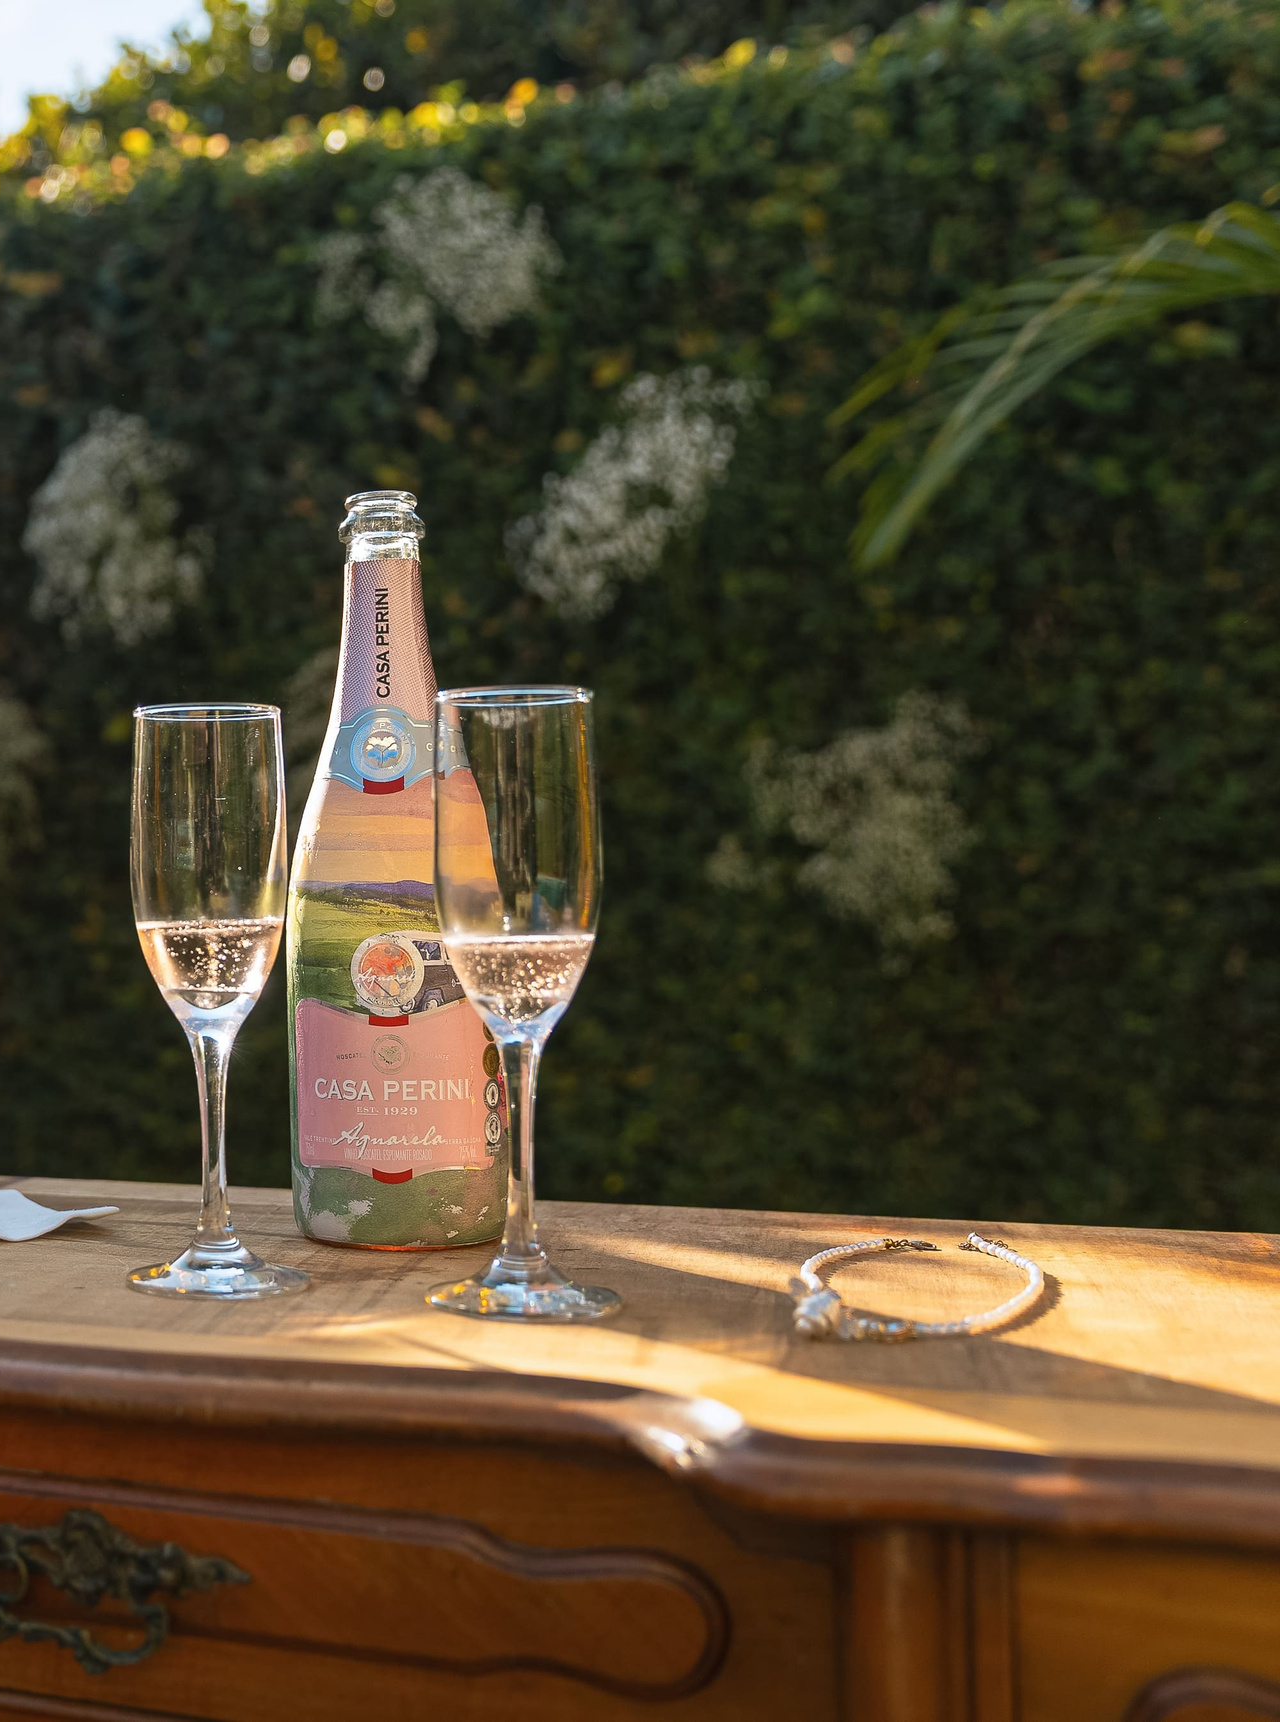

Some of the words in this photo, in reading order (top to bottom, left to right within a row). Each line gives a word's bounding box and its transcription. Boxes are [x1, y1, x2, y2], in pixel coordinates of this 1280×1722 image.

[375, 588, 390, 646] PERINI
[376, 650, 391, 698] CASA
[353, 967, 416, 991] Aquarel
[336, 1052, 367, 1060] MOSCATE
[314, 1078, 375, 1101] CASA
[383, 1078, 471, 1101] PERINI
[384, 1106, 418, 1116] 1929
[332, 1121, 445, 1160] Aquarela
